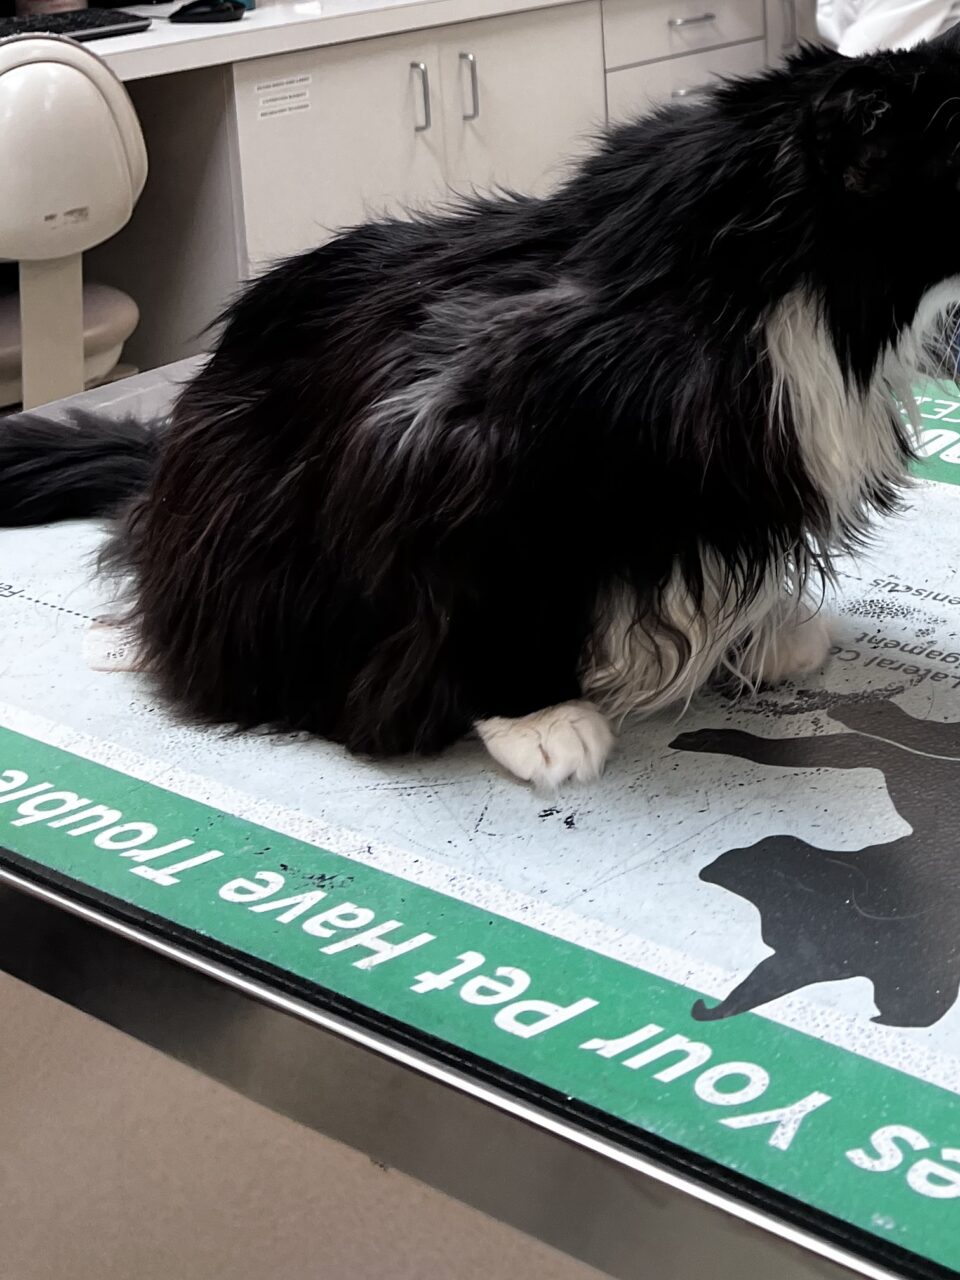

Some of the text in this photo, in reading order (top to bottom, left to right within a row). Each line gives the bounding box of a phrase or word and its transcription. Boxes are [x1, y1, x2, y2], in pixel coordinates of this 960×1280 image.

[217, 869, 435, 972] Have
[413, 949, 598, 1040] Pet
[579, 1023, 833, 1152] Your
